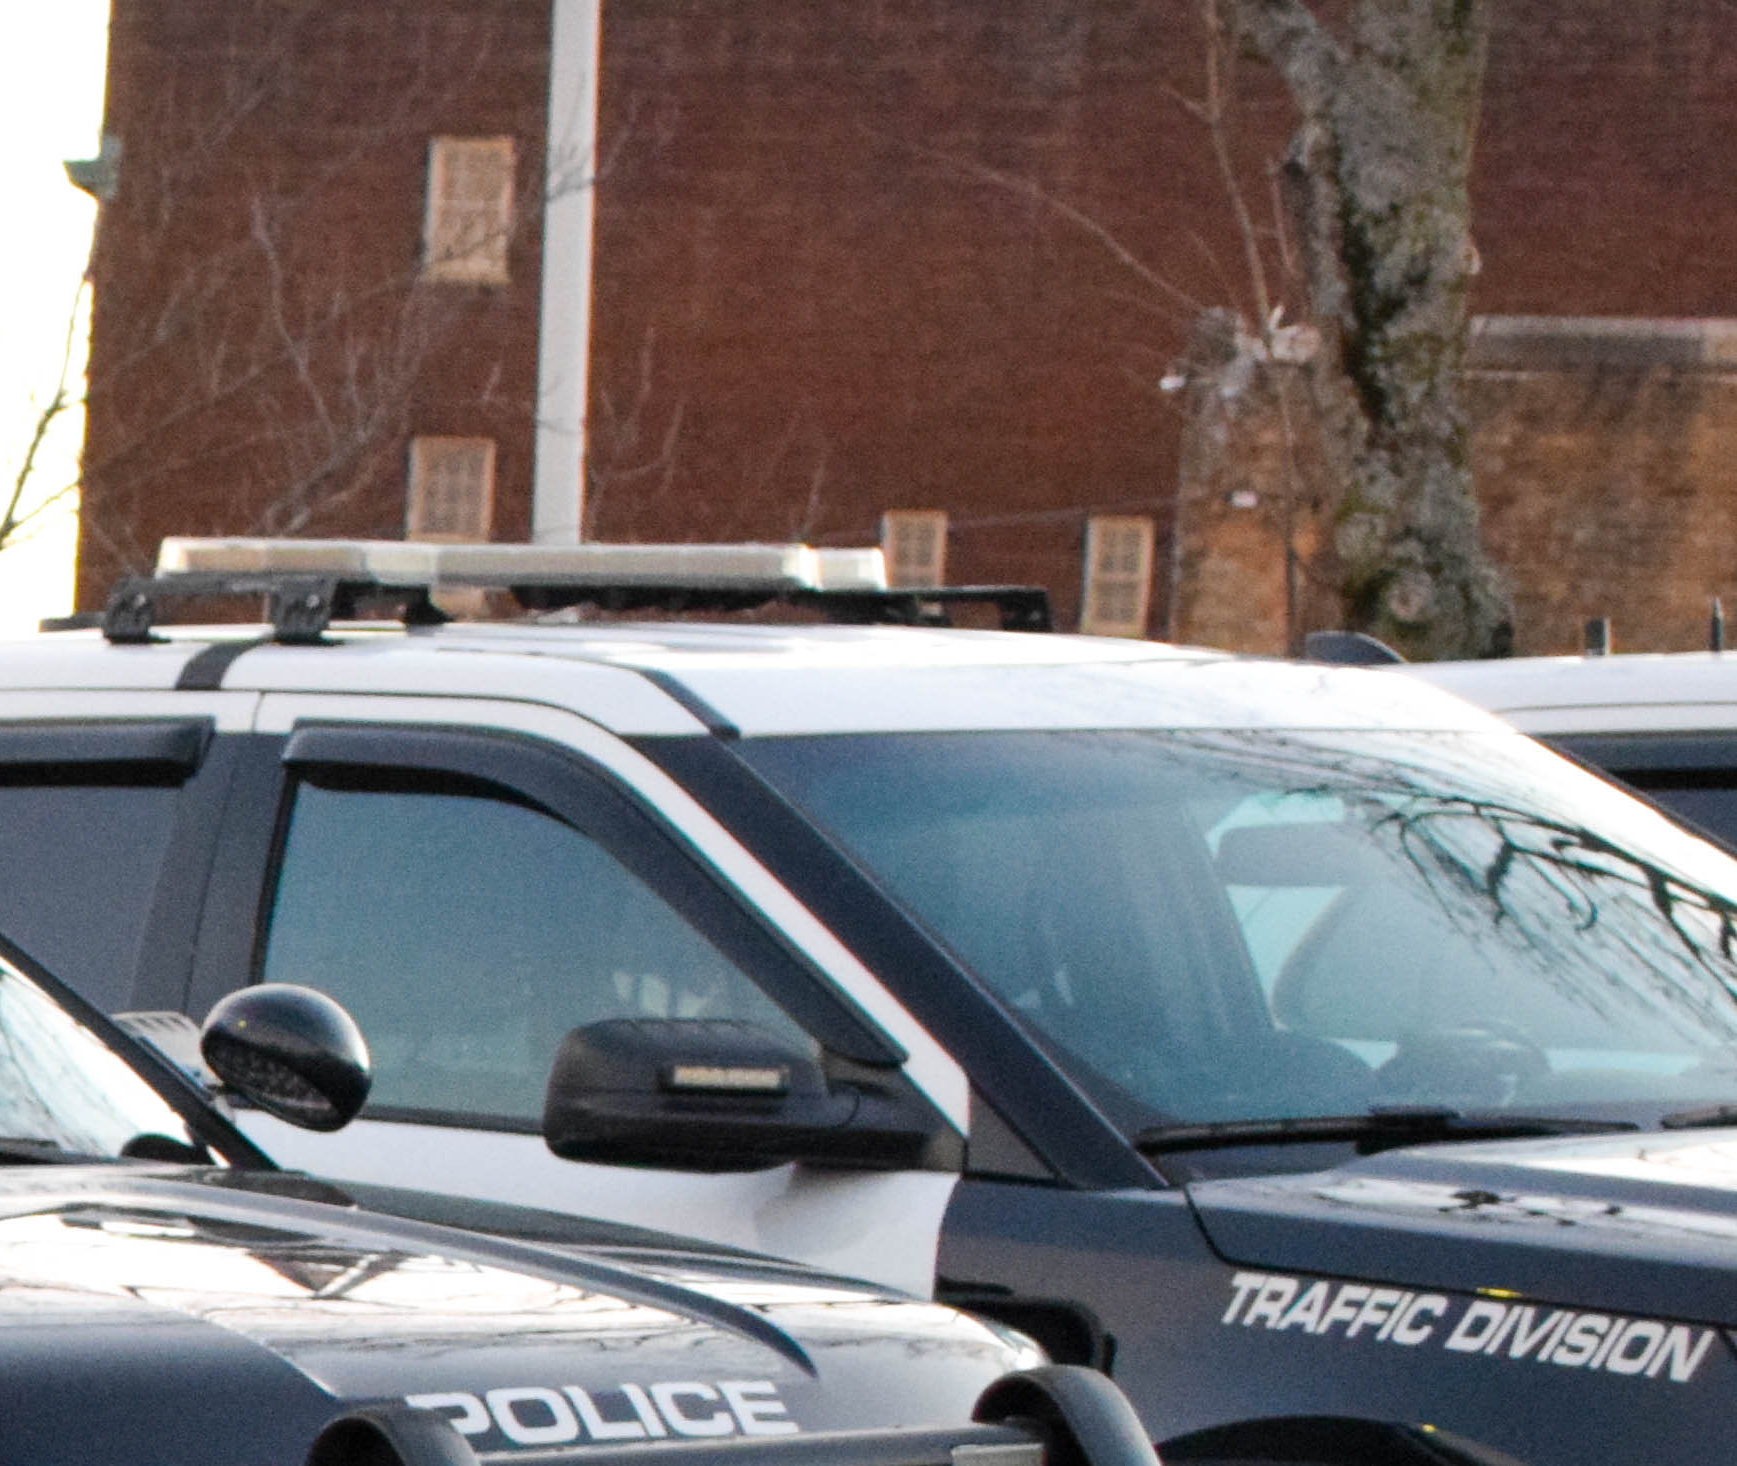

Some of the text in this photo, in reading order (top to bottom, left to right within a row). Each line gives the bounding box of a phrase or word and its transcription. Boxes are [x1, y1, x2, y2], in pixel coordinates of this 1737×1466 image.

[1222, 1271, 1716, 1383] TRAFFIC DIVISION
[404, 1380, 799, 1445] POLICE
